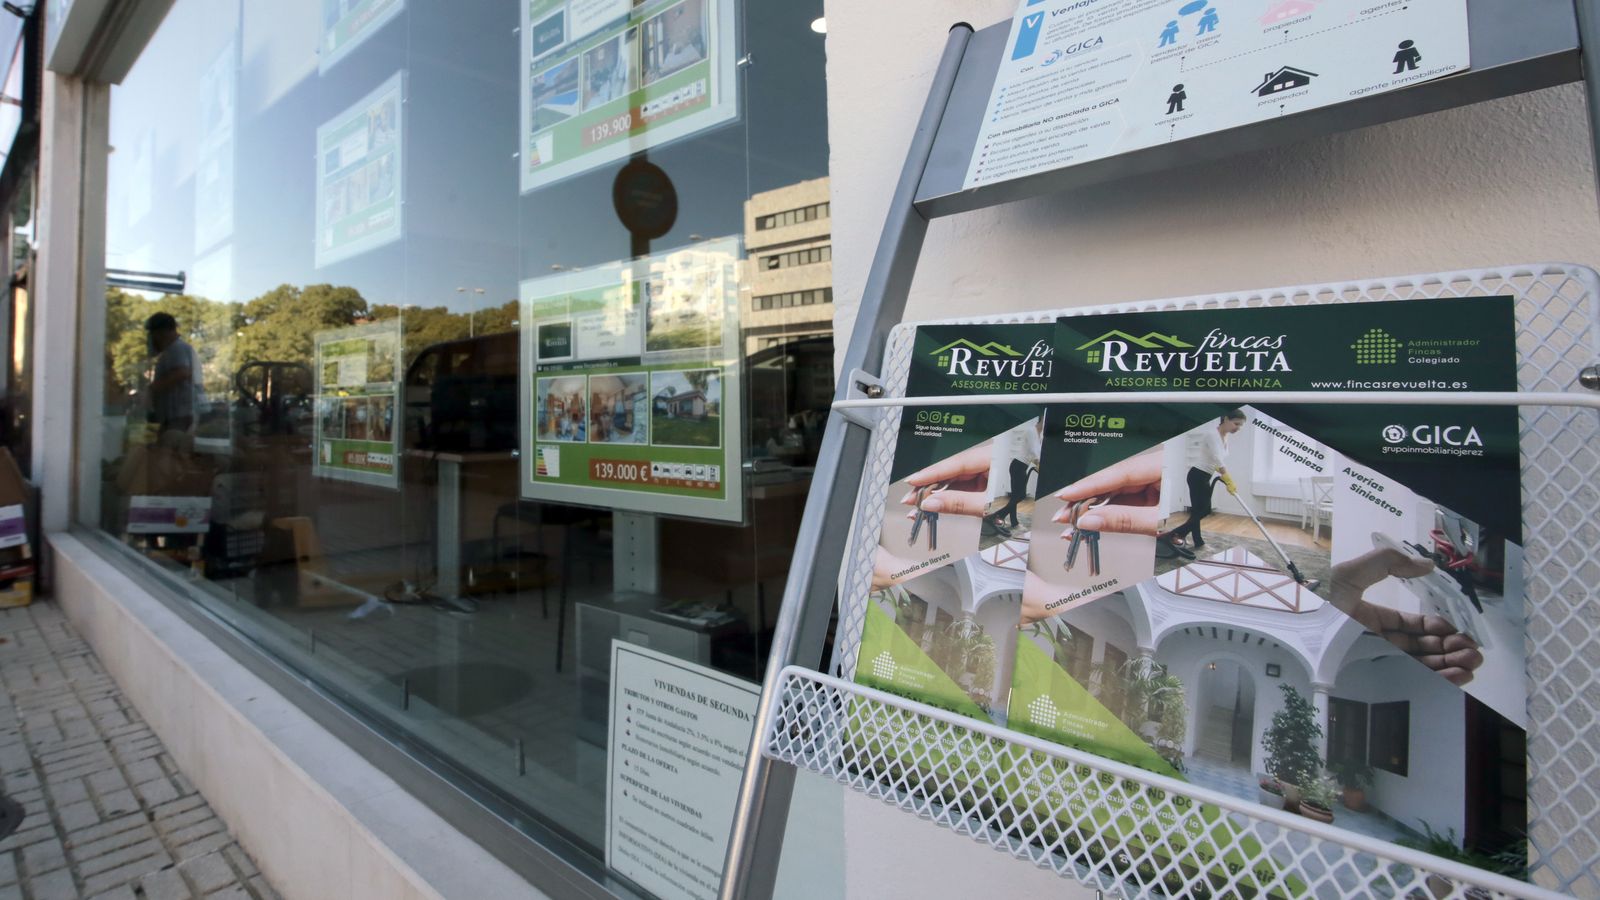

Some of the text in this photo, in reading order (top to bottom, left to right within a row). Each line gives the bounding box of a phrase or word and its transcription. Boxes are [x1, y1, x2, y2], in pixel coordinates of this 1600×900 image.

[1052, 0, 1098, 17] Ventaj
[1263, 15, 1311, 34] propiedad
[1066, 36, 1104, 54] GICA
[1349, 63, 1457, 97] agente inmobiliario
[1042, 116, 1054, 124] NO
[1054, 105, 1090, 120] asociada
[1098, 96, 1120, 107] GICA
[1257, 89, 1309, 108] propiedad
[591, 114, 632, 142] 139.900
[1154, 113, 1195, 127] vendedor
[1021, 338, 1054, 365] fin
[1193, 327, 1288, 357] fincas
[1408, 338, 1481, 347] Administrador
[1408, 348, 1441, 356] Fincas
[946, 348, 1052, 378] REVUE
[1098, 340, 1293, 373] REVUELTA
[1408, 356, 1460, 365] Colegiado
[951, 380, 1000, 391] ASESORES
[1003, 381, 1018, 391] DE
[1105, 376, 1283, 388] ASESORES DE CONFIANZA
[1311, 380, 1467, 390] www.fincasrevuelta.es
[915, 424, 930, 432] Sigue
[1064, 430, 1082, 440] Sigue
[1252, 418, 1325, 460] Mantenimiento
[1412, 424, 1483, 447] GICA
[1279, 445, 1323, 473] Limpieza
[1382, 446, 1484, 456] grupoinmobiliariojerez
[595, 463, 648, 481] 139.000 €
[1342, 466, 1385, 493] Averías
[1349, 483, 1403, 517] Siniestros
[890, 553, 951, 581] Custodia de llaves
[1044, 577, 1119, 612] Custodia de llaves
[654, 678, 751, 722] VIVIENDAS DE SEGUNDA
[655, 698, 674, 712] OTROS
[674, 706, 697, 722] GASTOS
[621, 742, 678, 774] PLAZO DE LA OFERTA
[670, 797, 703, 819] VIVIENDAS
